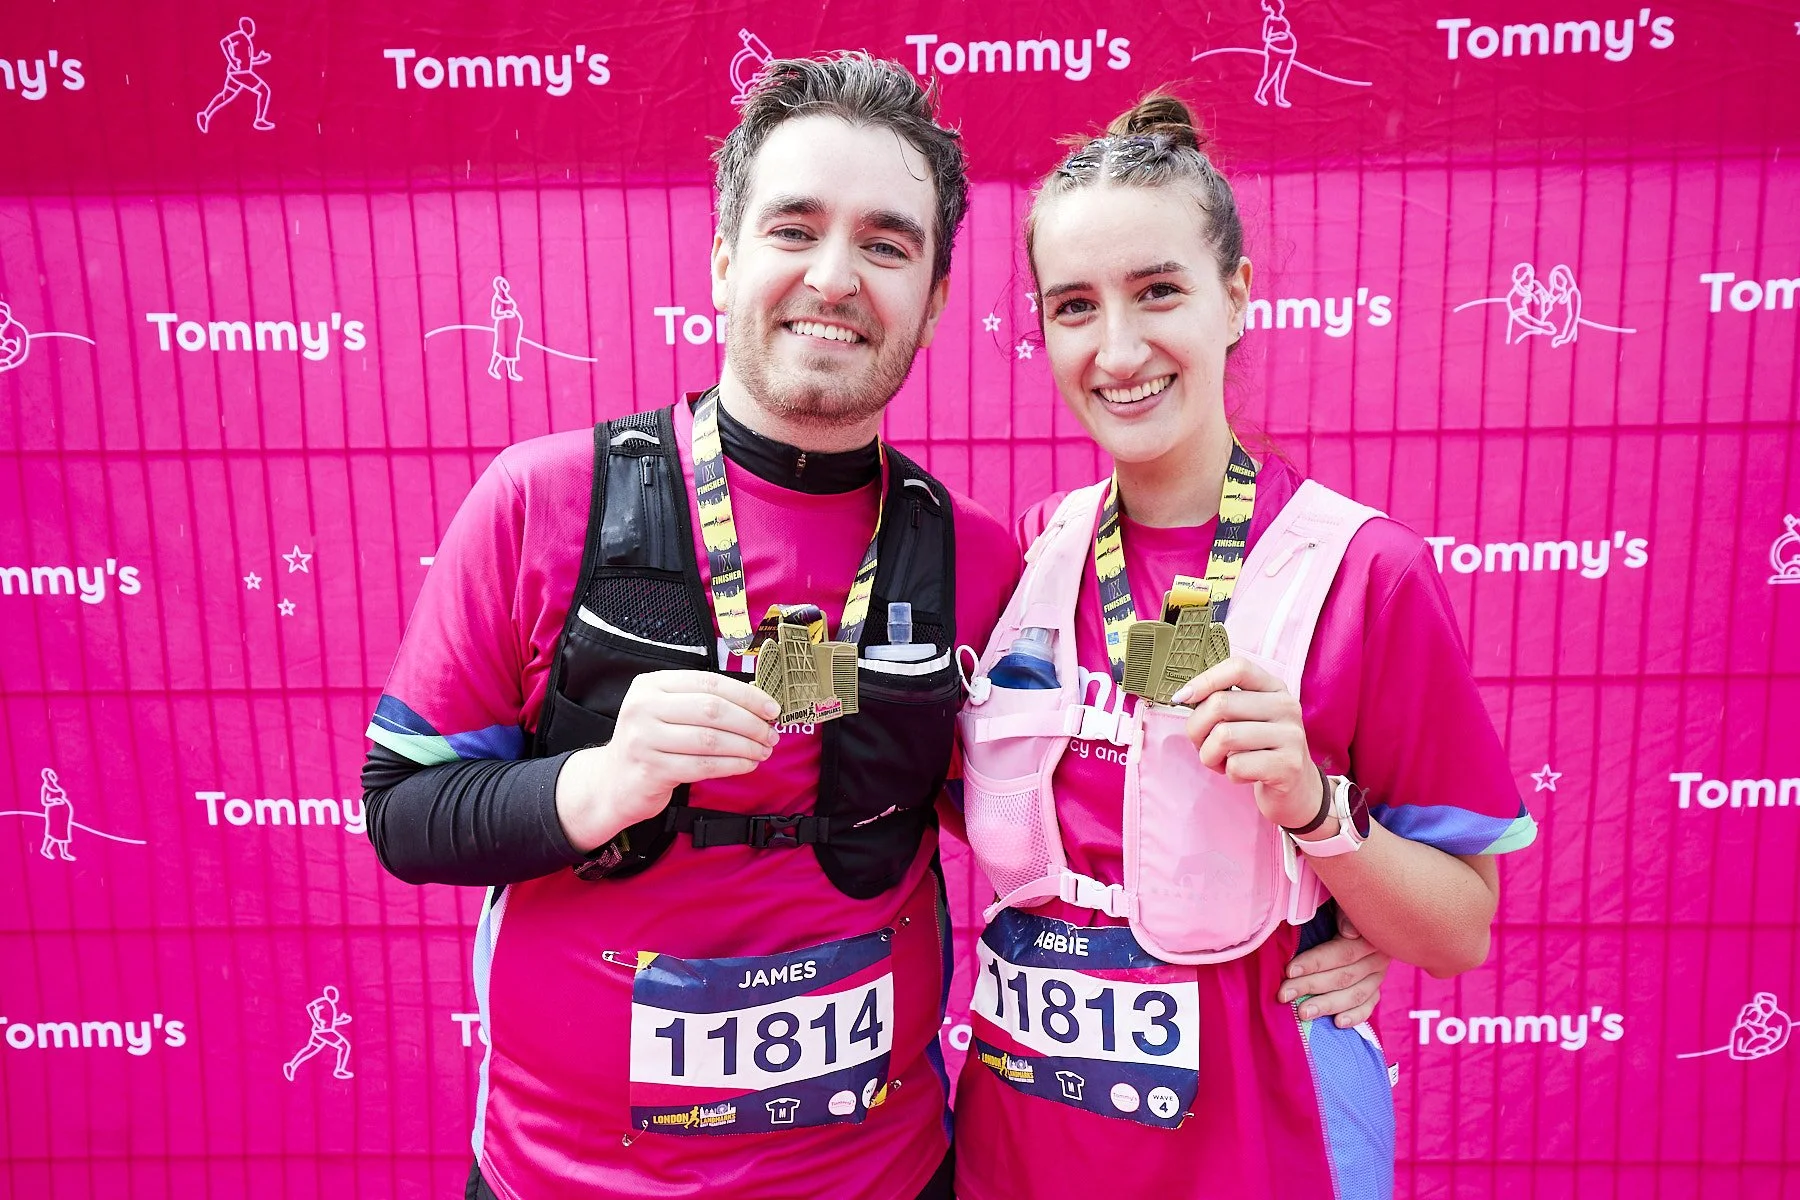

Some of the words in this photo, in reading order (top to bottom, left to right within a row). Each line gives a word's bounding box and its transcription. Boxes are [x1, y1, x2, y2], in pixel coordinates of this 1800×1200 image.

[1436, 9, 1675, 62] Tommy's
[383, 44, 611, 96] Tommy's
[905, 30, 1131, 91] Tommy's
[146, 313, 367, 361] Tommy's
[653, 306, 727, 345] To
[1229, 463, 1256, 478] FINISHER
[696, 477, 726, 496] FINISHER
[1214, 539, 1246, 548] FINISHER
[1423, 530, 1648, 579] Tommy's
[712, 569, 742, 586] FINISHER
[1104, 593, 1132, 614] FINISHER
[782, 708, 808, 723] LONDON
[1070, 740, 1090, 759] cy
[195, 791, 367, 835] Tommy
[1033, 930, 1090, 957] ABBIE
[738, 960, 817, 989] JAMES
[988, 957, 1181, 1057] 11813
[0, 1013, 186, 1056] ommy's
[655, 987, 884, 1078] 11814
[1408, 1006, 1624, 1051] Tommy's
[1152, 1094, 1174, 1102] WAVE
[1159, 1102, 1169, 1113] 4
[653, 1112, 690, 1125] LONDON
[778, 1107, 787, 1119] M
